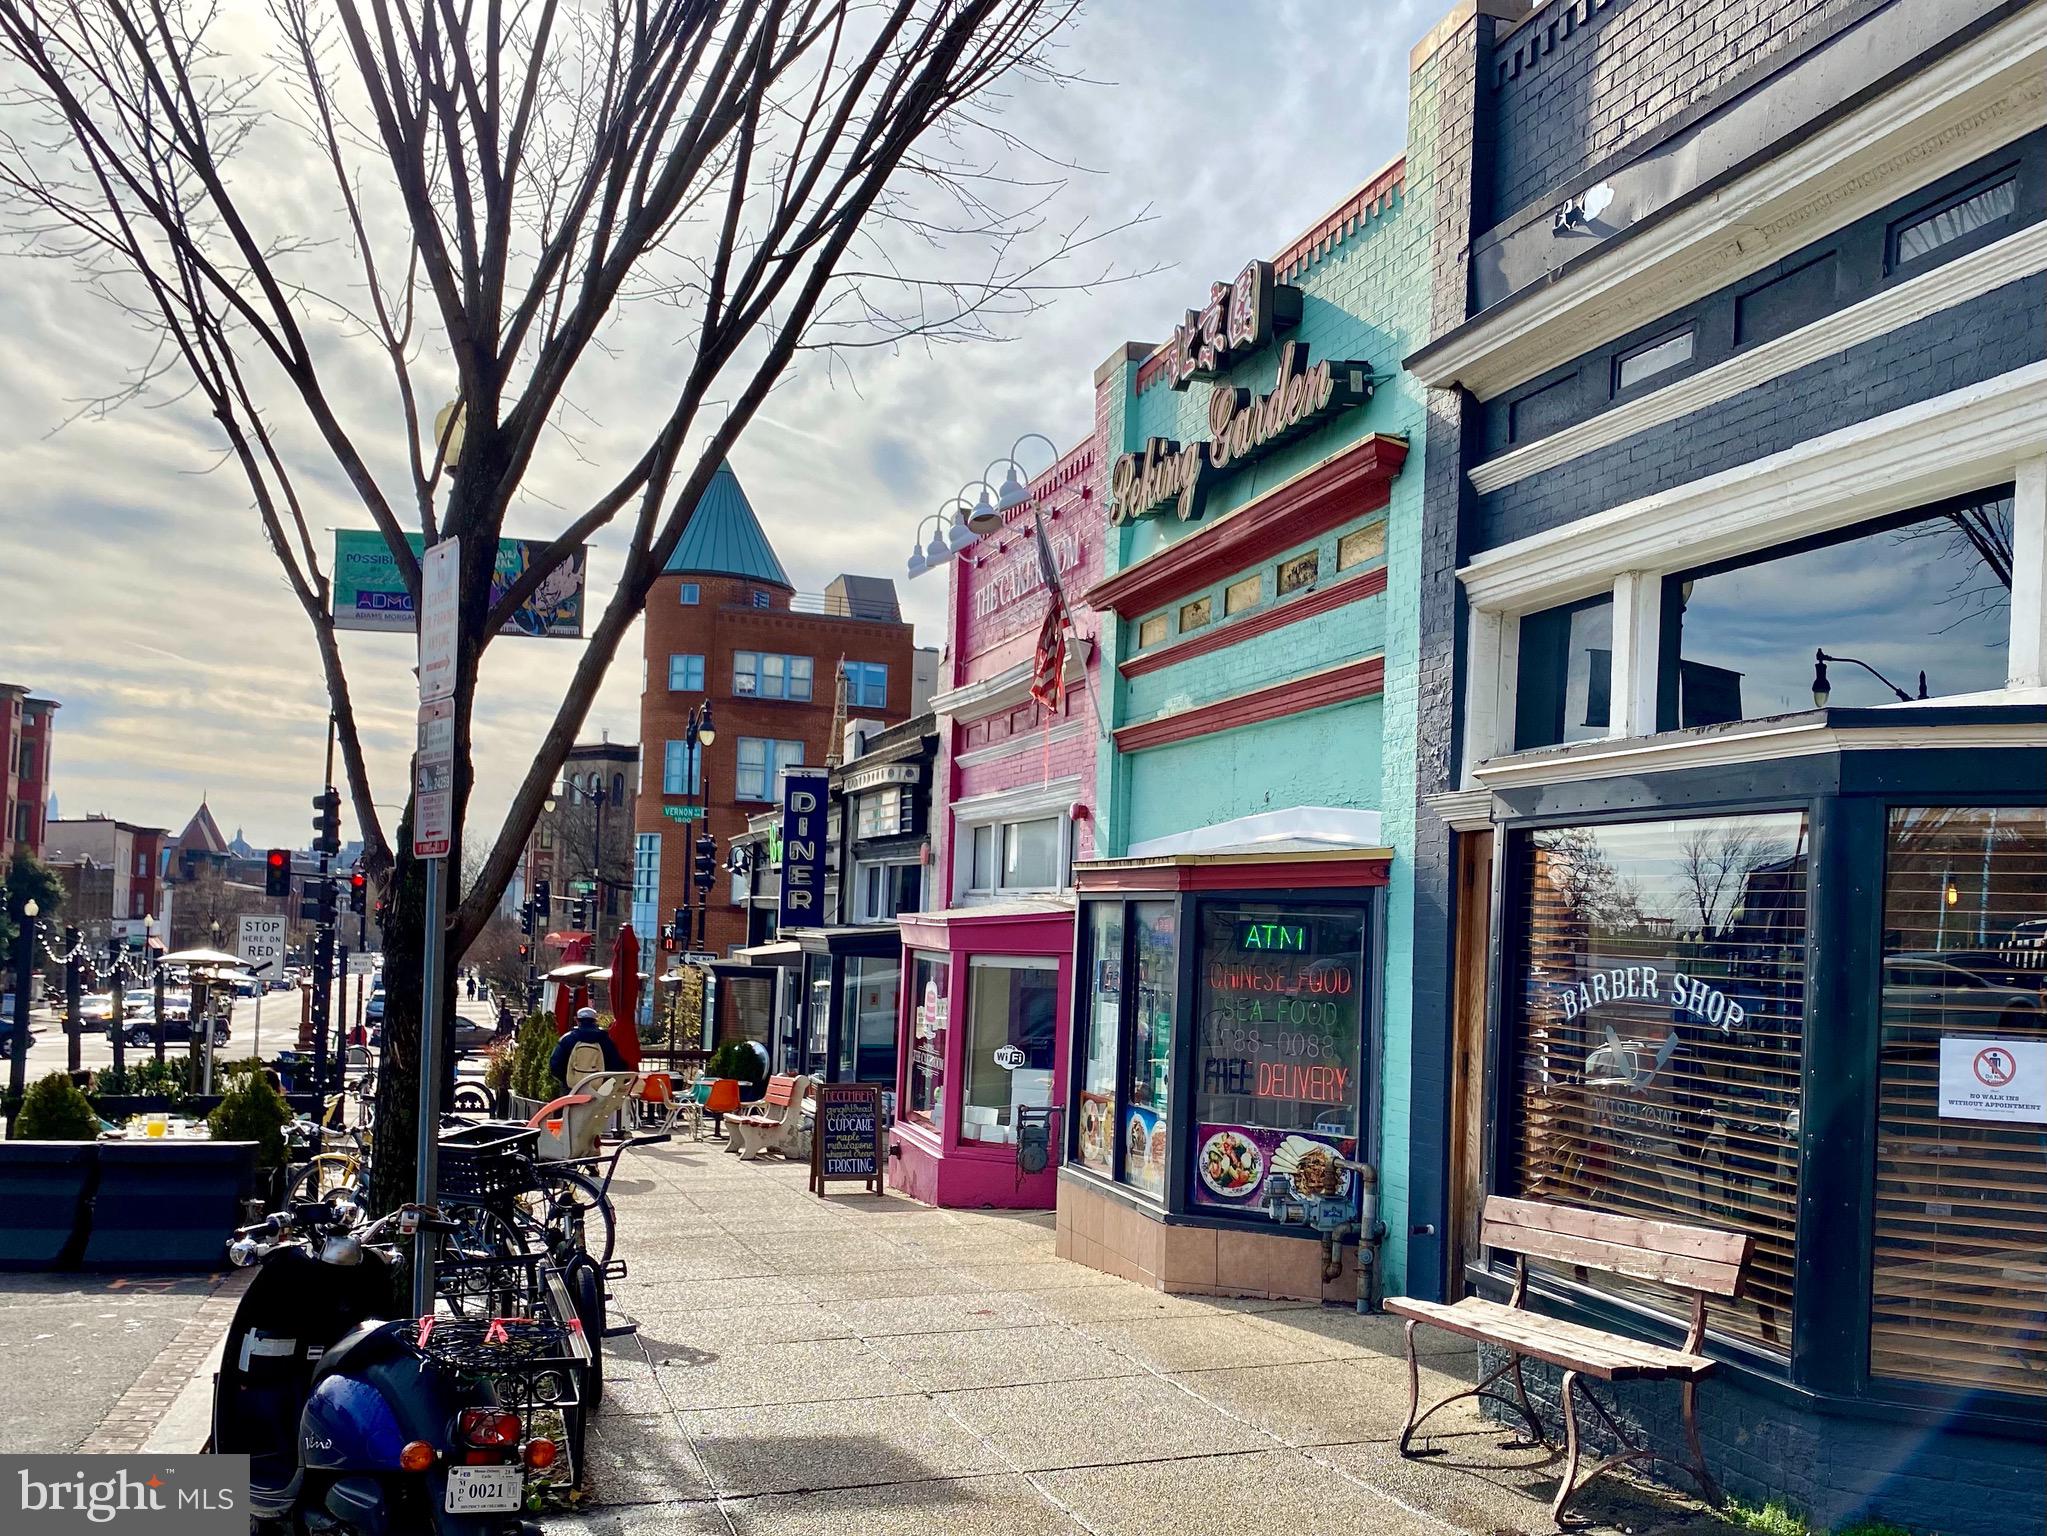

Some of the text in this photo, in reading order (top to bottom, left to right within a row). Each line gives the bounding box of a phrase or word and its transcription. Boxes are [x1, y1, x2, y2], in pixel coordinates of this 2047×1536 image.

[1110, 340, 1335, 527] Peking Garden
[976, 578, 998, 620] THE
[355, 612, 382, 621] ADAMS
[664, 807, 694, 817] VERNON
[787, 791, 817, 910] DINER
[245, 921, 280, 933] STOP
[242, 935, 281, 943] HERE ON
[1245, 924, 1303, 950] ATM
[248, 945, 274, 957] RED
[1210, 961, 1351, 994] CHINESE FOOD
[1562, 966, 1746, 1037] BARBER SHOP
[1223, 998, 1337, 1026] SEA FOOD
[1204, 1057, 1348, 1101] FREE DELIVERY
[825, 1090, 874, 1103] DECEMBER
[1948, 1099, 1983, 1107] WITHOUT
[1985, 1101, 2042, 1111] APPOINTMENT
[828, 1118, 874, 1132] CUPCAKE
[1645, 1106, 1686, 1134] OWL
[836, 1132, 860, 1144] maple
[828, 1158, 874, 1173] FROSTING
[468, 1483, 503, 1499] 0021
